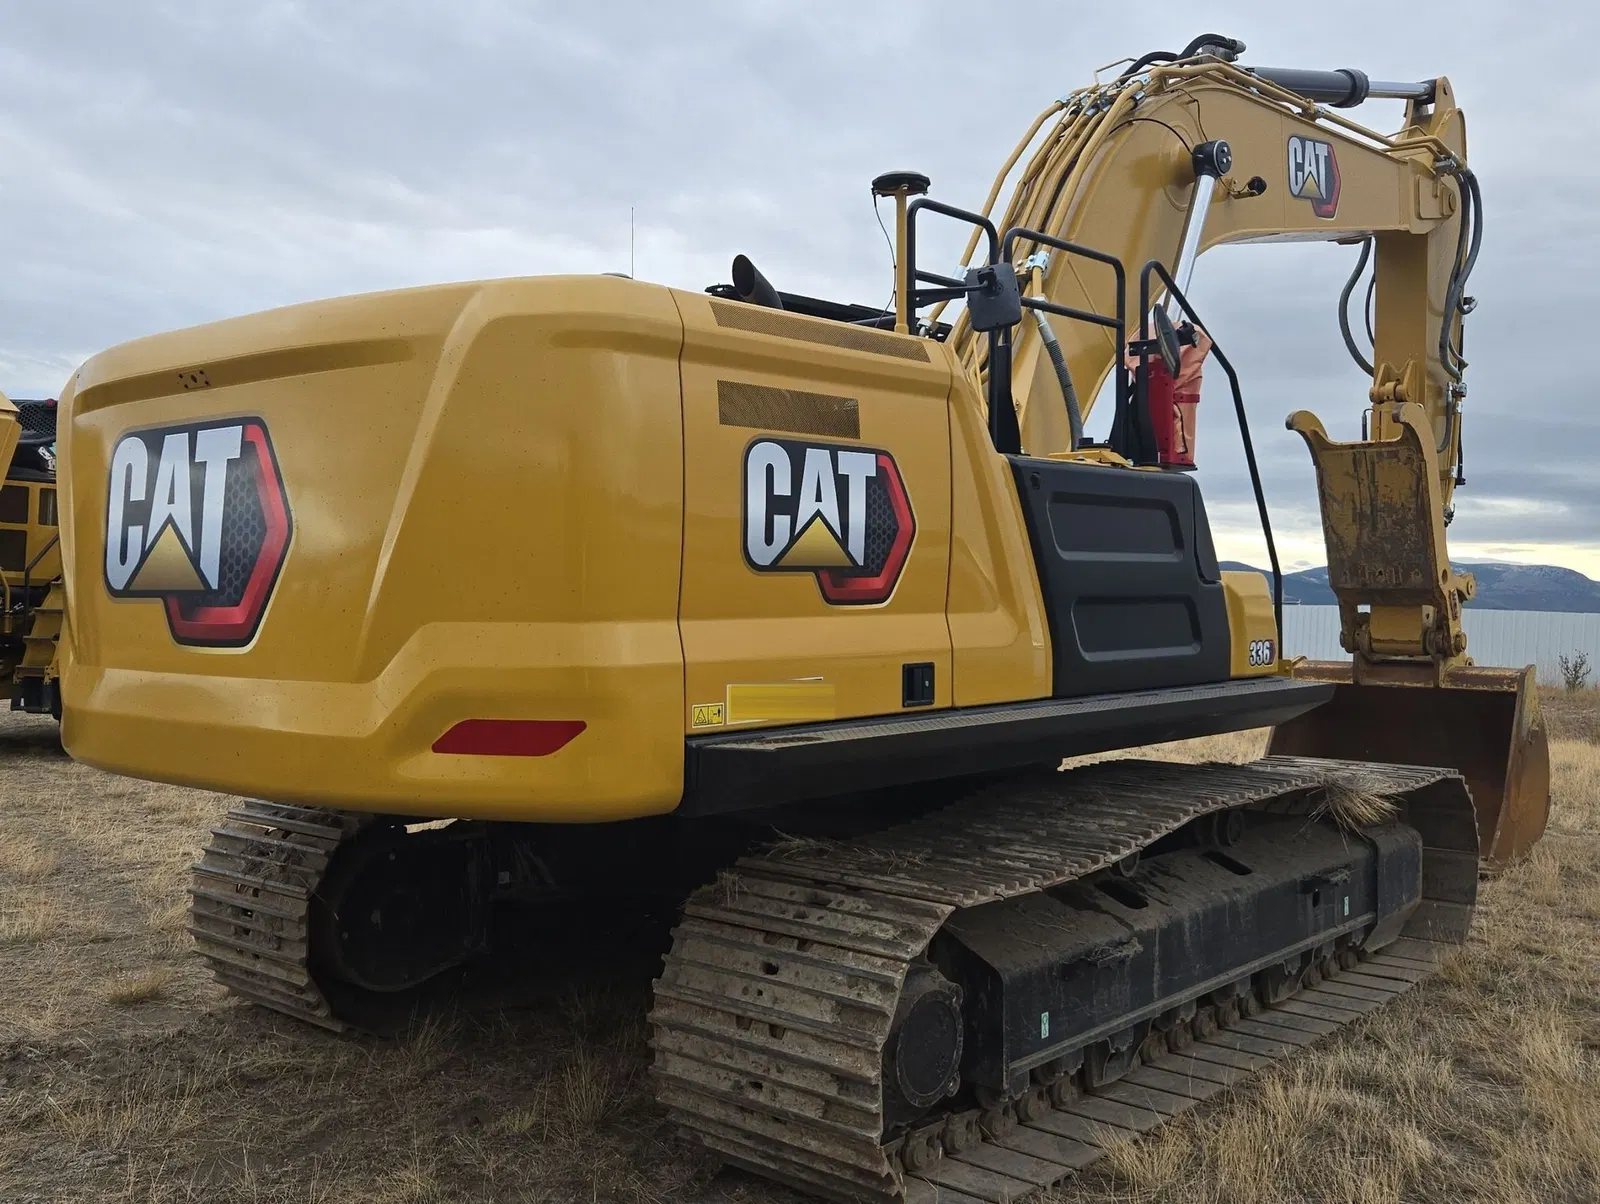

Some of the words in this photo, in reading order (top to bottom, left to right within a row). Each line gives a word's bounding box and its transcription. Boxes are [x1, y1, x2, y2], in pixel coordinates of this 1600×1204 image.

[1288, 136, 1328, 199] CAT
[106, 425, 243, 590] CAT
[747, 441, 876, 566] CAT
[1250, 641, 1270, 665] 336
